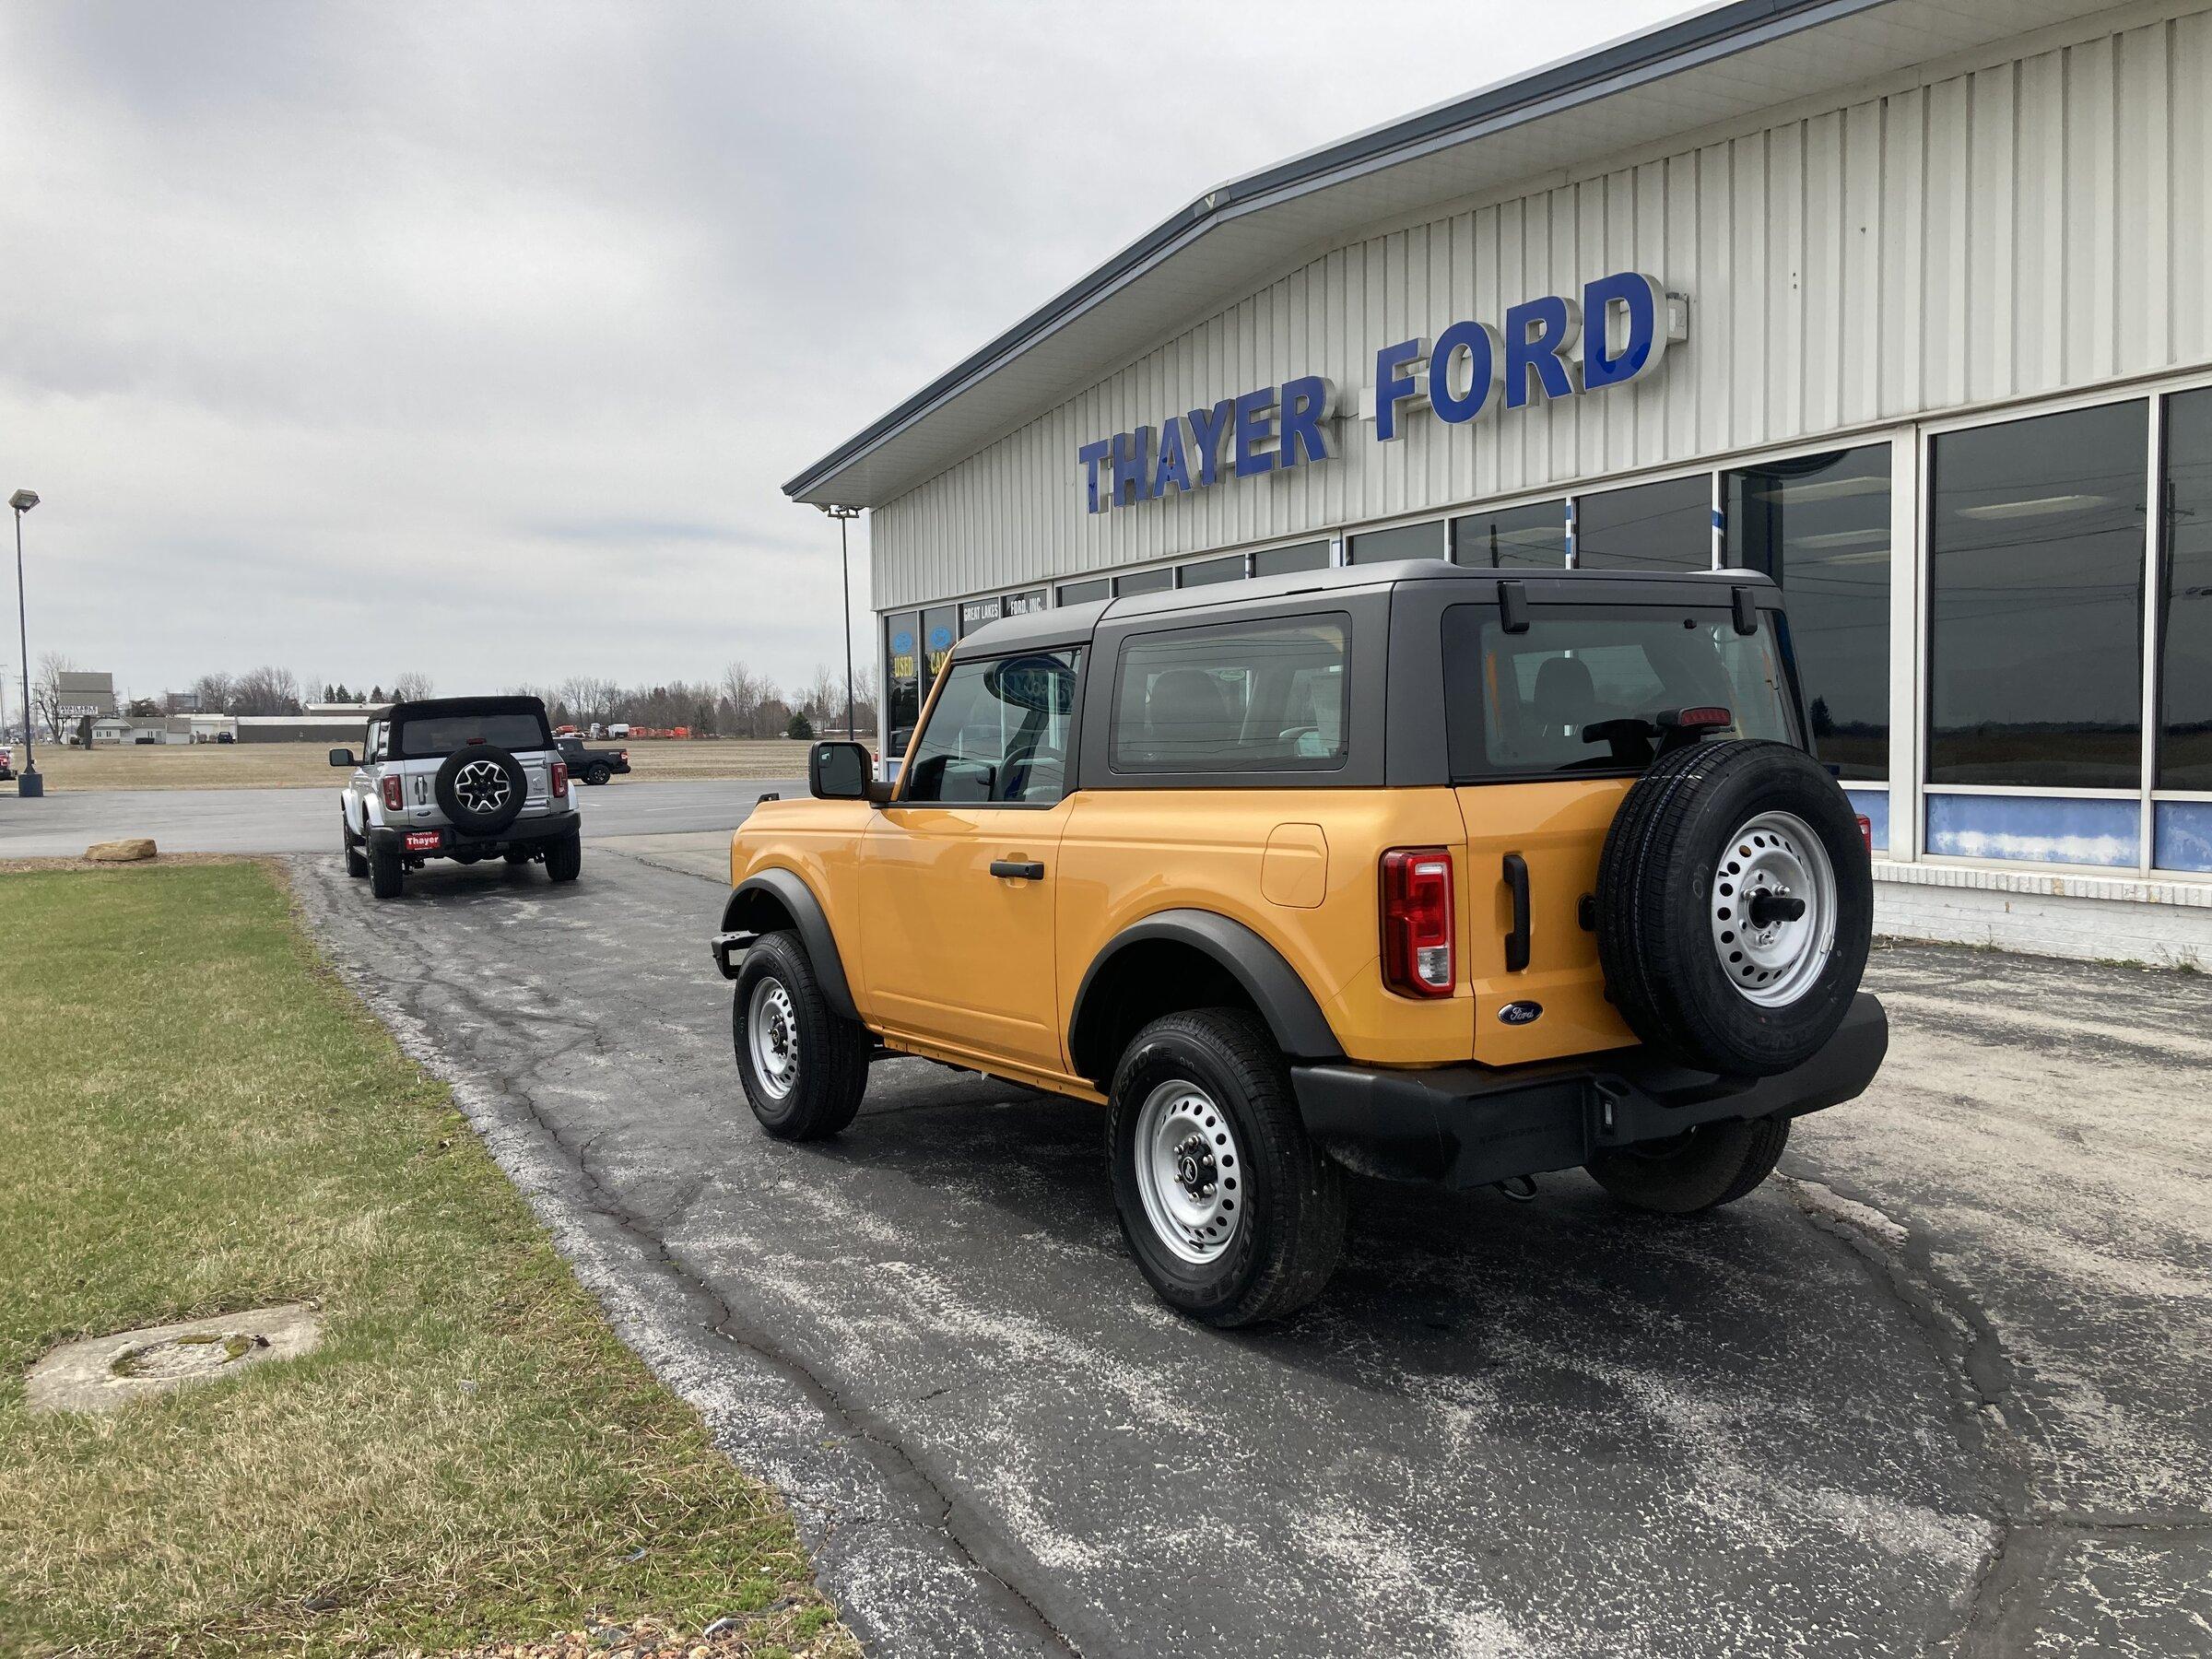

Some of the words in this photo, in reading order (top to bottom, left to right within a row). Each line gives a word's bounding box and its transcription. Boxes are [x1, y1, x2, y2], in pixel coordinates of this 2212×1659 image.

[1077, 375, 1328, 514] THAYER
[1375, 271, 1657, 442] FORD
[963, 606, 981, 622] GREAT
[982, 603, 999, 619] LAKES
[1029, 596, 1043, 613] INC.
[893, 655, 913, 677] USED
[406, 836, 439, 846] Thayer
[1510, 1006, 1535, 1021] Ford
